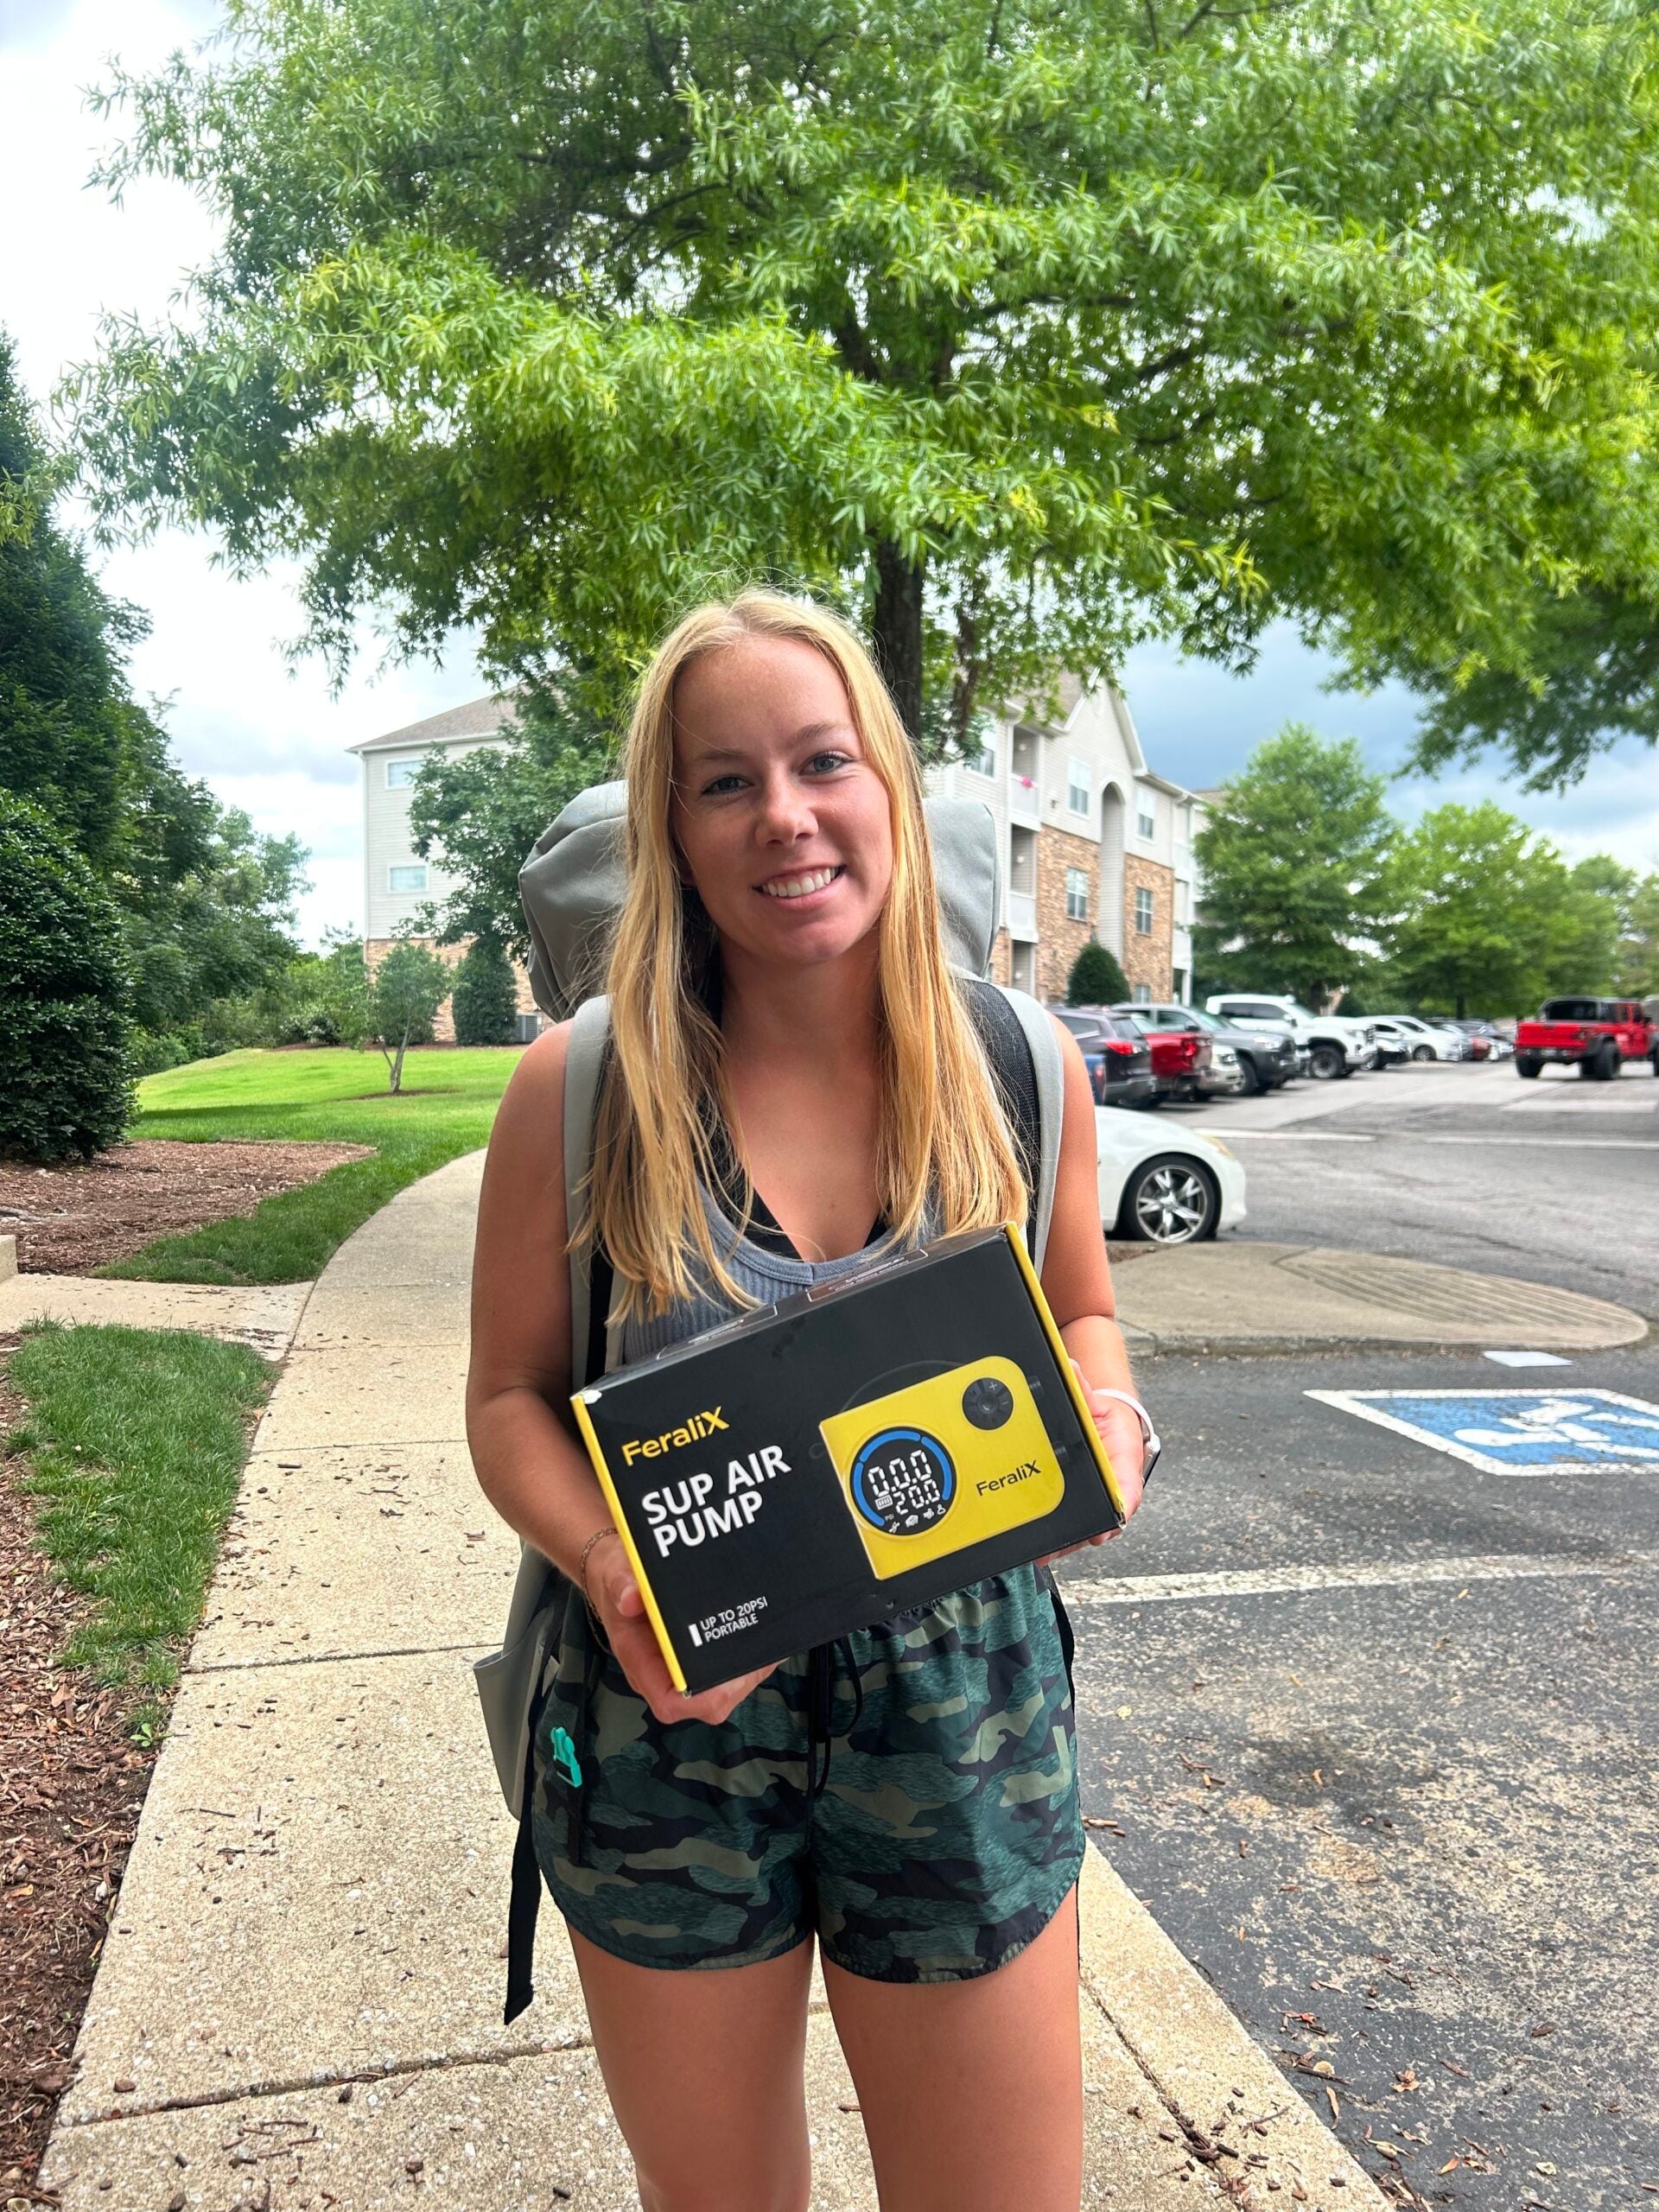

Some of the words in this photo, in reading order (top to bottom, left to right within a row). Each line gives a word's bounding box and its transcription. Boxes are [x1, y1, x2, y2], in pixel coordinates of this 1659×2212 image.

[621, 1406, 729, 1466] FeraliX
[642, 1473, 714, 1525] SUP
[728, 1445, 791, 1494] AIR
[893, 1478, 940, 1515] 20.0
[976, 1460, 1041, 1497] FeraliX
[653, 1491, 763, 1558] PUMP
[700, 1616, 716, 1631] UP
[718, 1609, 735, 1624] TO
[737, 1596, 768, 1616] 20PSI
[704, 1613, 759, 1643] PORTABLE
